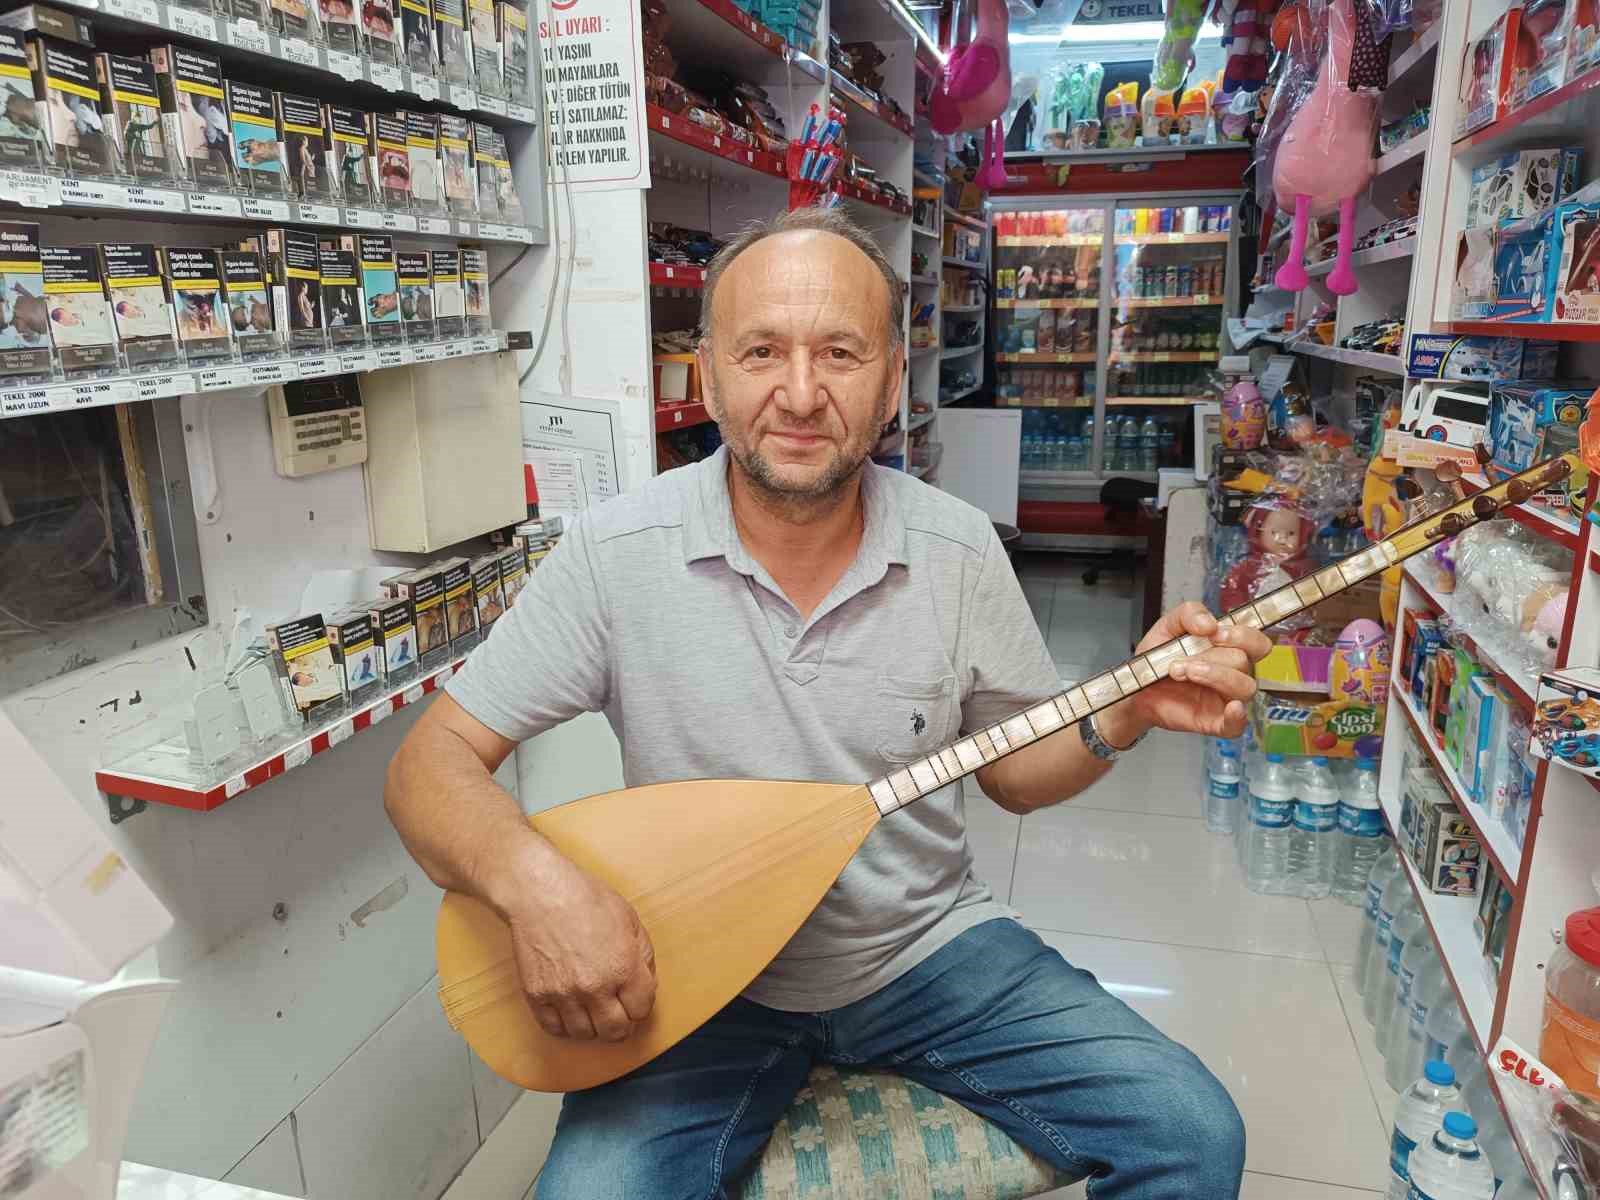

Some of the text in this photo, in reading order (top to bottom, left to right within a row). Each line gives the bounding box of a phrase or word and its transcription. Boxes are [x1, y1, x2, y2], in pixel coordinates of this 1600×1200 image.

[1107, 3, 1152, 18] TEKEL
[566, 15, 602, 35] UYARI
[567, 85, 597, 103] DİĞER
[598, 81, 631, 99] TÜTÜN
[576, 126, 626, 144] HAKKINDA
[588, 147, 631, 164] YAPILIR.
[61, 180, 80, 188] KENT
[127, 187, 144, 195] KENT
[190, 193, 206, 201] KENT
[94, 384, 111, 392] 2000
[3, 390, 46, 401] TEKEL 2000
[28, 401, 49, 410] UZUN
